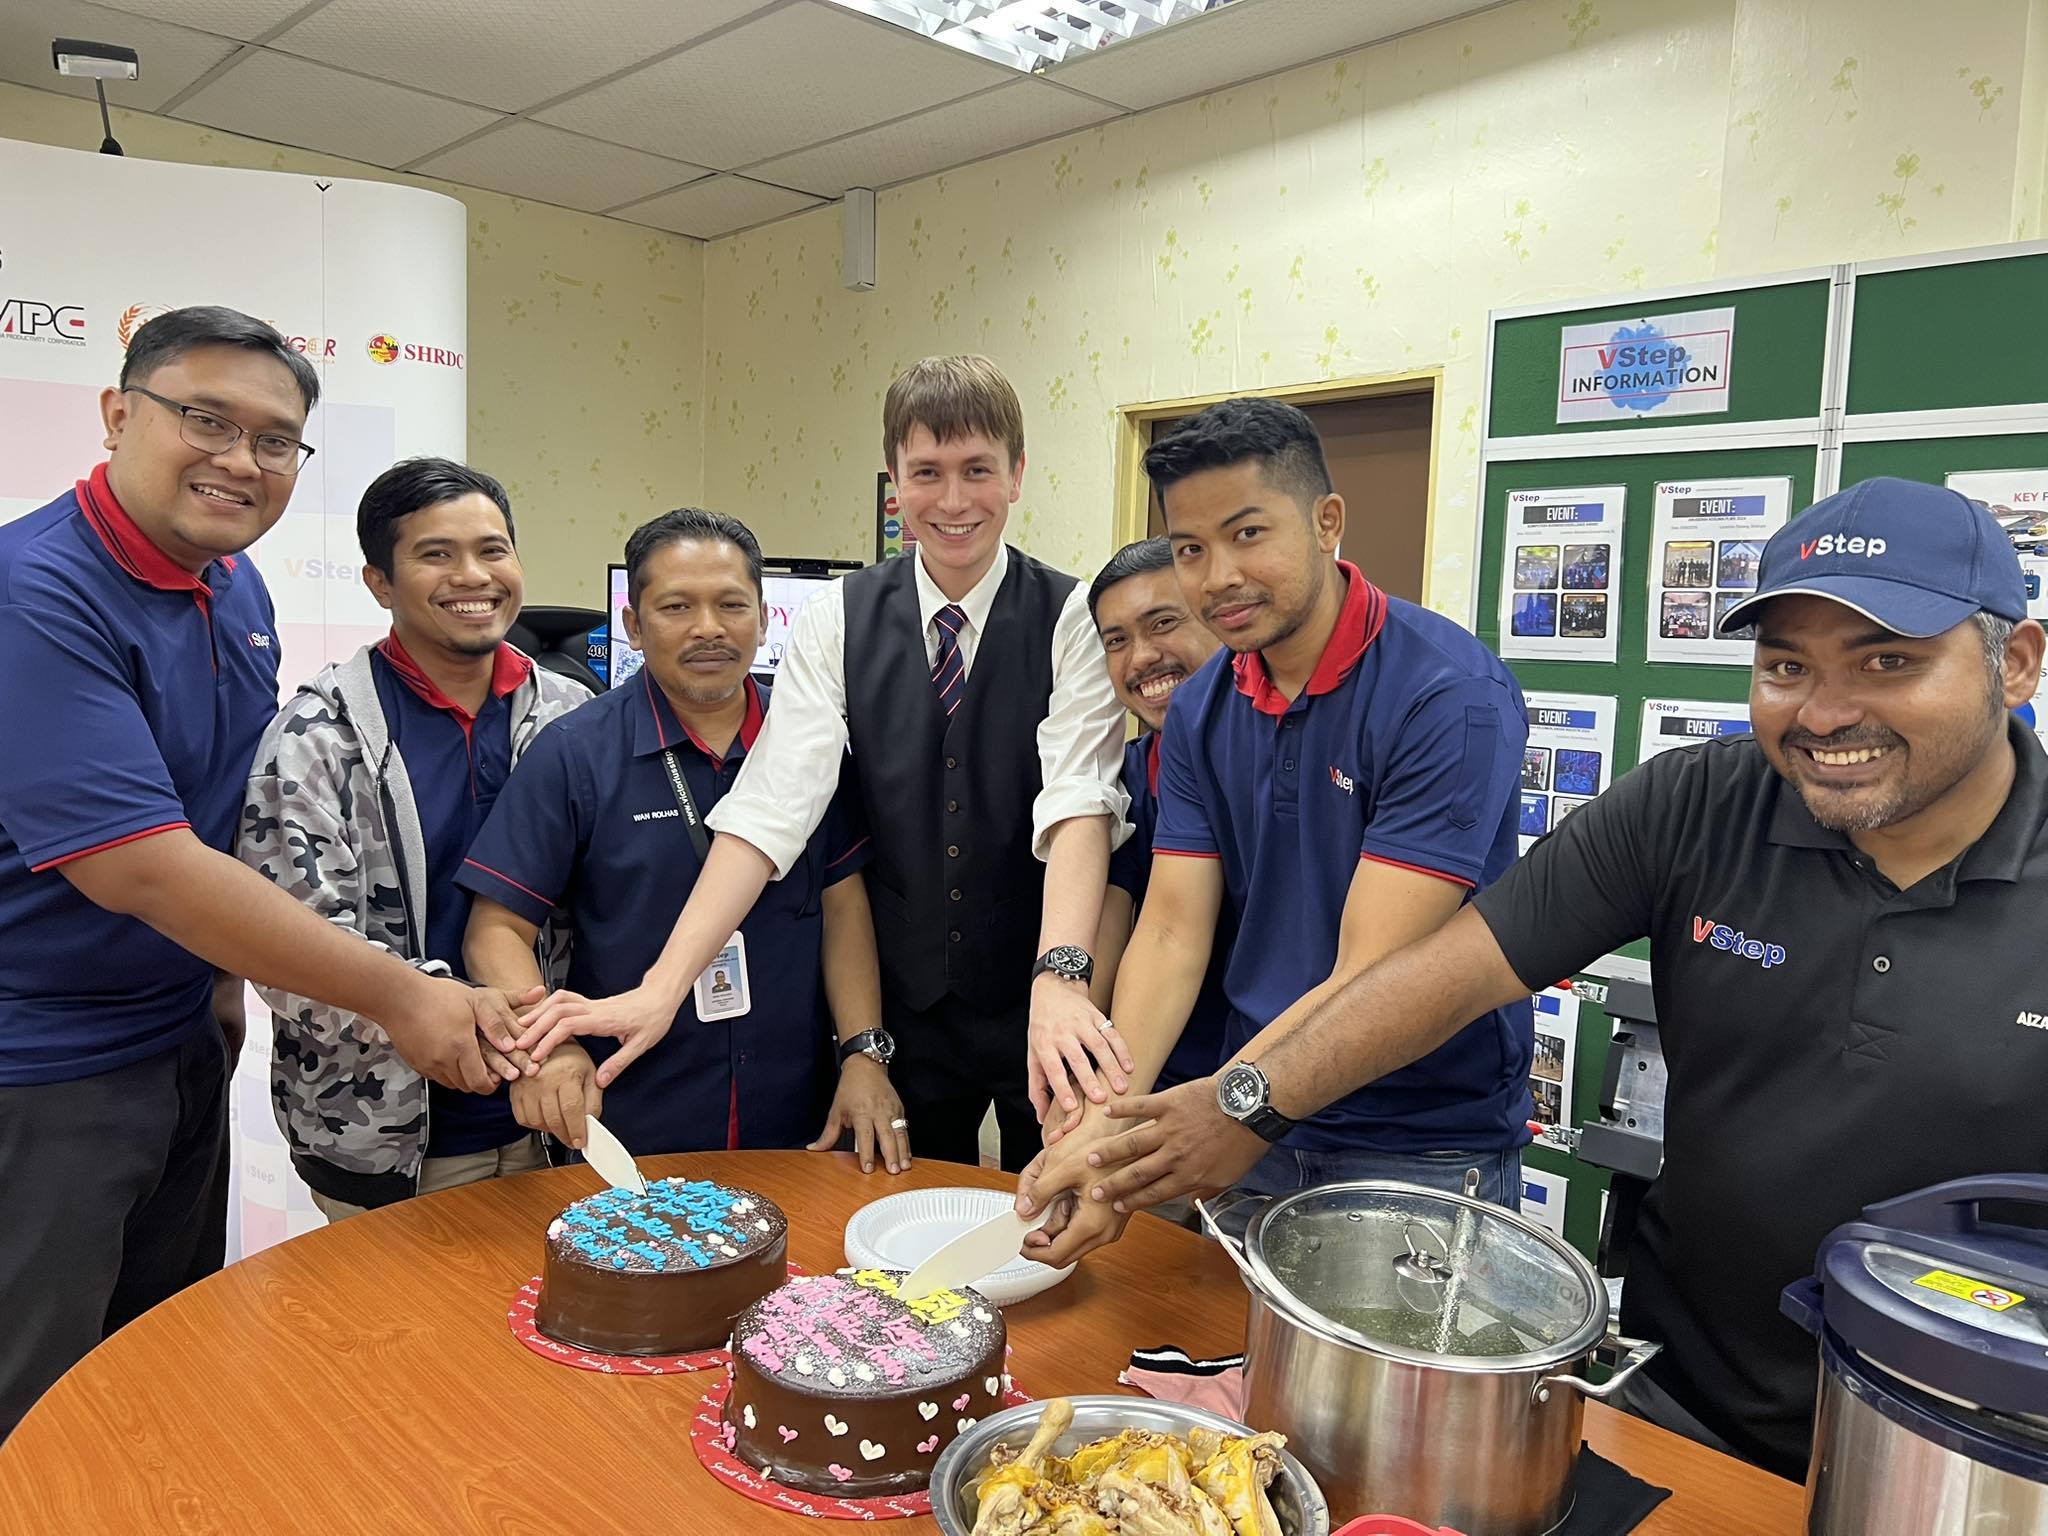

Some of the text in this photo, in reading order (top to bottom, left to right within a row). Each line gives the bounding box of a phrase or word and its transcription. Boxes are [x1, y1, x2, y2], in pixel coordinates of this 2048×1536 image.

[404, 343, 464, 370] SHRDC
[1597, 344, 1686, 369] VStep
[1572, 365, 1717, 393] INFORMATION
[1660, 485, 1692, 494] VStep
[2014, 492, 2039, 502] KEY
[1512, 494, 1540, 502] VStep
[1546, 506, 1579, 521] EVENT:
[1699, 499, 1736, 514] EVENT:
[1799, 532, 1887, 560] VStep
[1648, 703, 1679, 712] VStep
[1538, 710, 1571, 725] EVENT:
[1686, 720, 1722, 735] EVENT:
[633, 812, 650, 822] WAN
[1692, 915, 1786, 969] VStep
